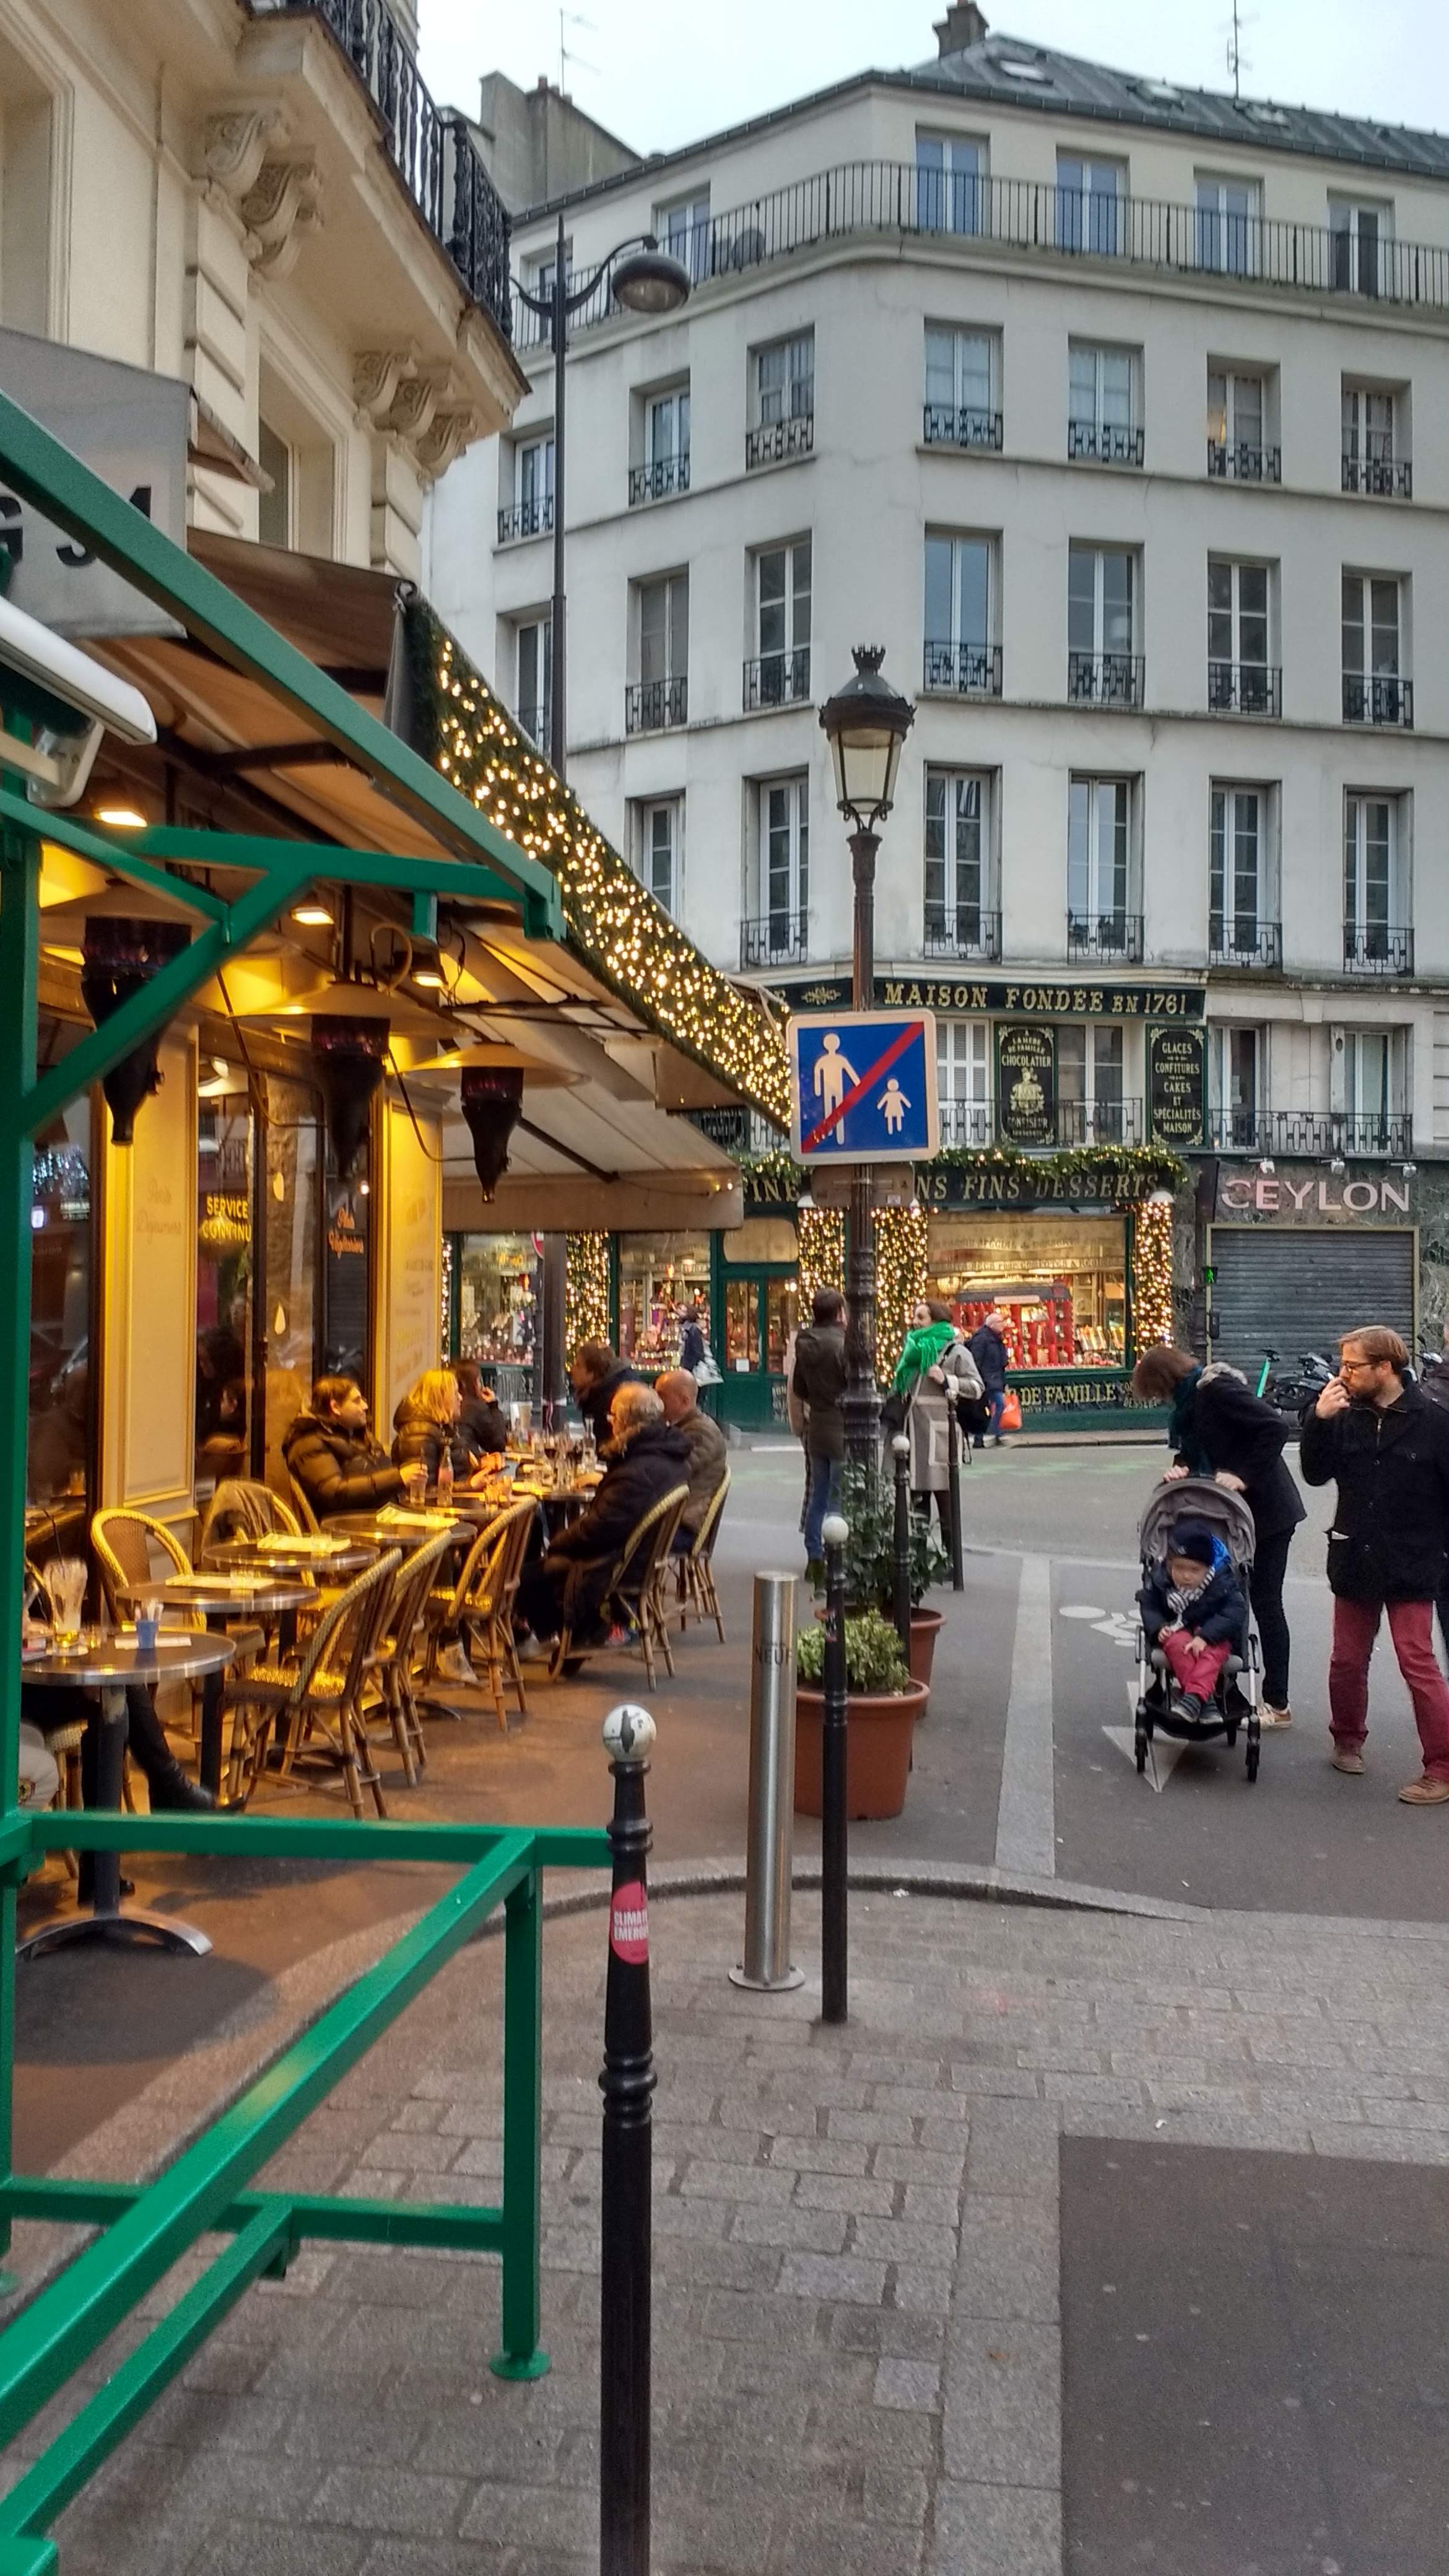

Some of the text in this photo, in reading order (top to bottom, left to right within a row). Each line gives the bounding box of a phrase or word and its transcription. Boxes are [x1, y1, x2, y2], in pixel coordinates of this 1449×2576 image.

[884, 982, 988, 1007] MAISON
[1112, 995, 1139, 1014] EN
[1144, 993, 1186, 1014] 1761
[1007, 1044, 1046, 1055] DE FAMILLE
[1162, 1042, 1192, 1055] GLACES
[1001, 1055, 1051, 1068] CHOCOLATIER
[1155, 1061, 1199, 1074] CONFITURES
[1164, 1082, 1191, 1093] CAKES
[1173, 1096, 1181, 1106] ET
[1153, 1107, 1201, 1120] SPÉCIALITÉS
[1163, 1122, 1192, 1134] MAISON
[962, 1175, 1020, 1201] FINS
[1035, 1173, 1159, 1199] DESSERTS
[1221, 1179, 1409, 1212] CEYLON
[207, 1195, 248, 1219] SERVICE
[202, 1219, 251, 1242] CONTINU
[1020, 1386, 1042, 1406] DE
[1044, 1382, 1117, 1404] FAMILLE
